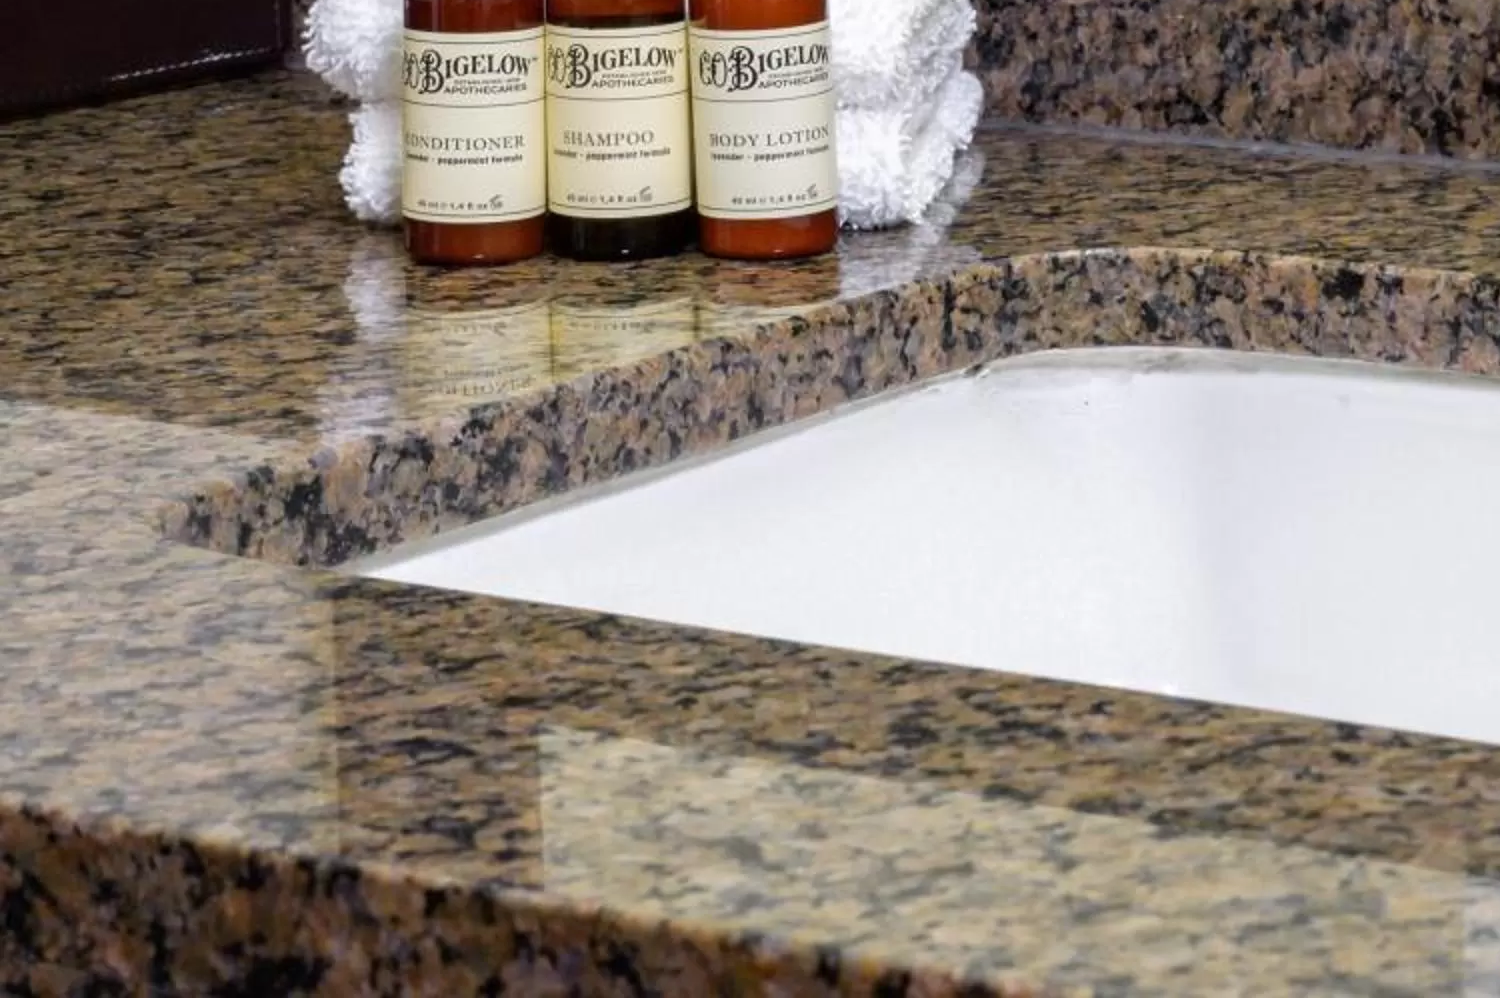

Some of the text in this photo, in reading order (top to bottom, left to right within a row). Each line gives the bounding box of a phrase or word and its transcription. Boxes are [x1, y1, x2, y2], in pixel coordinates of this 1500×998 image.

[564, 43, 676, 89] BIGELOW
[562, 128, 655, 147] SHAMPOO
[708, 124, 829, 148] BODY LOTION
